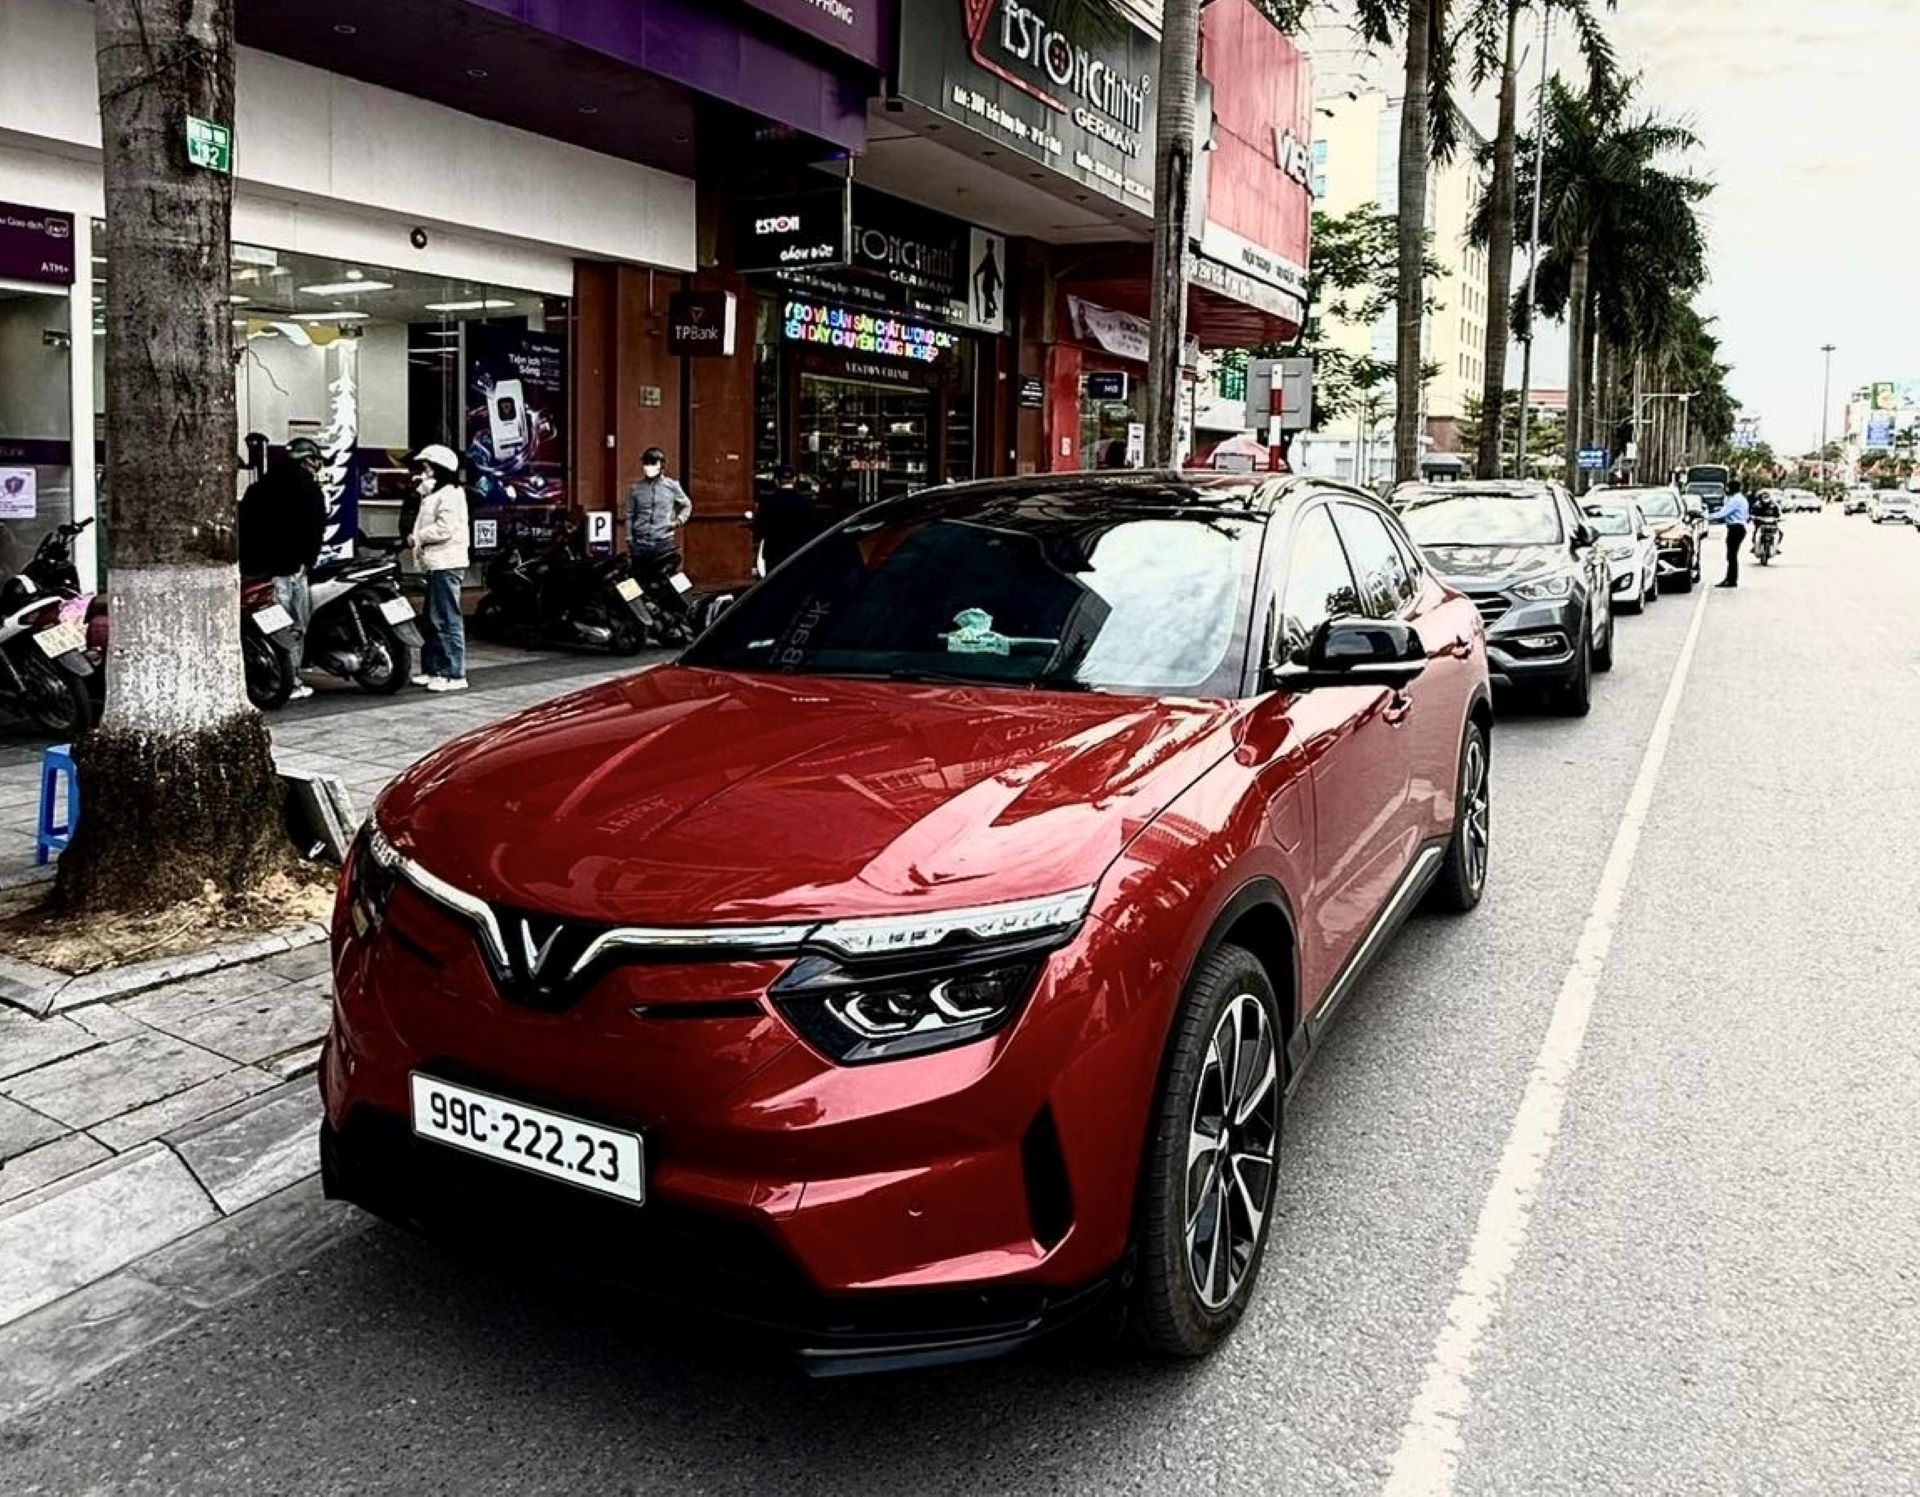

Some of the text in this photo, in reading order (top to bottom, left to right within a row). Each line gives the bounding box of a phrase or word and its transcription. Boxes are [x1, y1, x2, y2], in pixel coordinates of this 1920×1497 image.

[1074, 107, 1143, 158] GERMANY
[674, 325, 719, 341] TPBank
[595, 516, 606, 537] P
[430, 1091, 620, 1183] 99C-222.23
